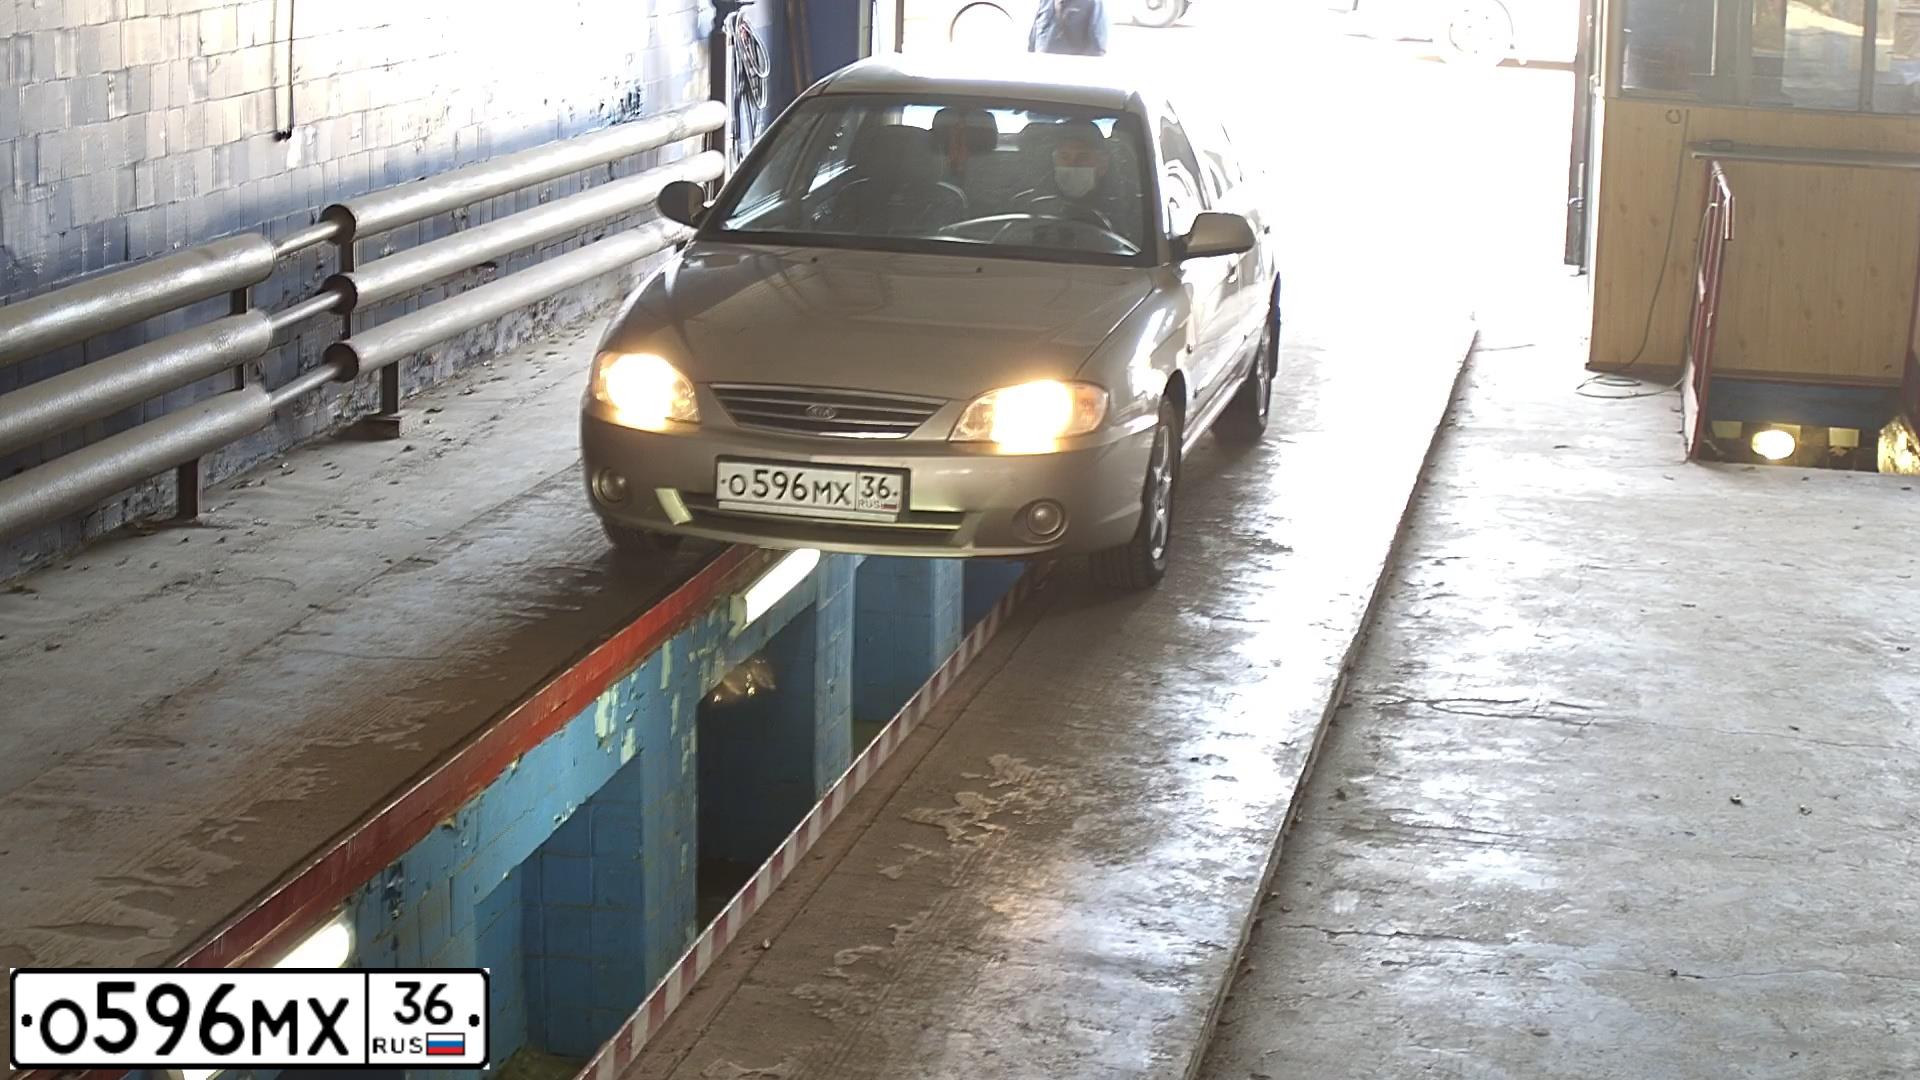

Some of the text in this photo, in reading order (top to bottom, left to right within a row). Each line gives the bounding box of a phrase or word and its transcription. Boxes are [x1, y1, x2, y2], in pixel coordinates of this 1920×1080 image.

[729, 469, 890, 505] O596MX 36
[858, 499, 880, 508] RUS
